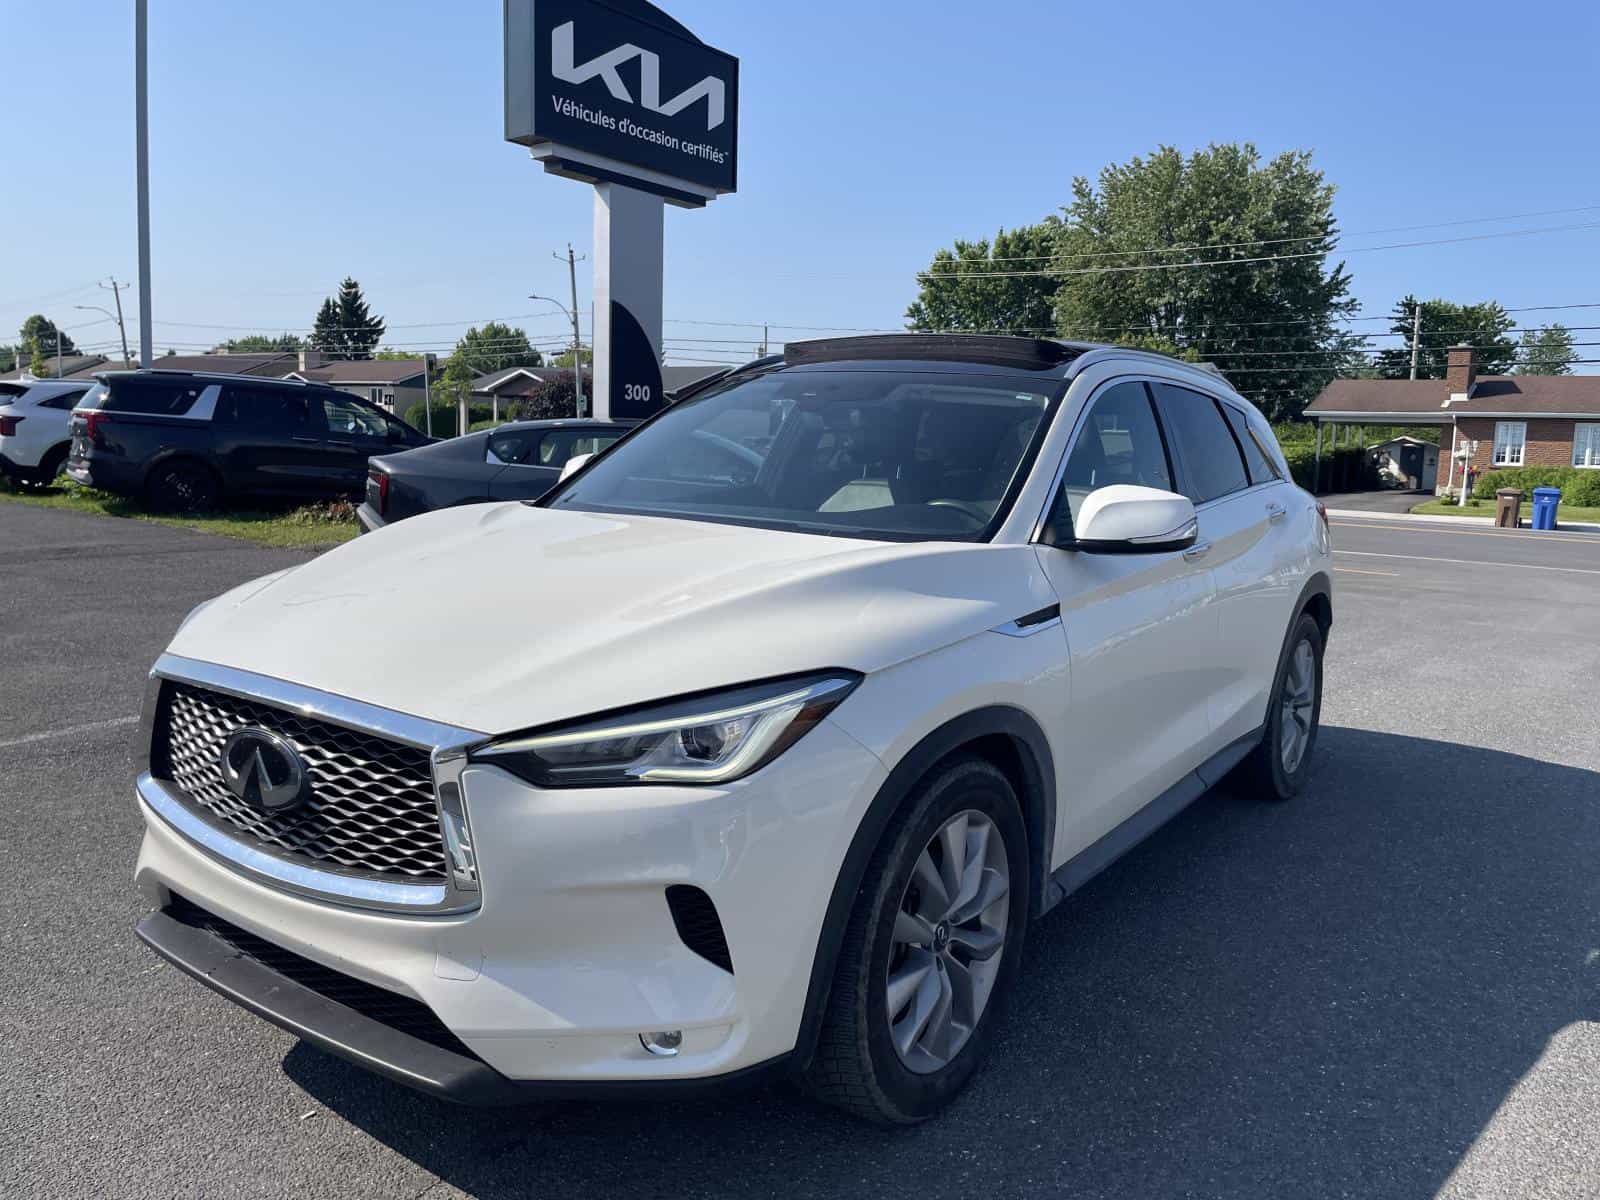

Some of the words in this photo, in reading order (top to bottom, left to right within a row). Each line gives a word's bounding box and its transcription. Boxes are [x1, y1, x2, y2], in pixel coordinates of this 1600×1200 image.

[552, 20, 725, 131] KIA
[552, 94, 616, 130] Véhicules
[618, 118, 679, 150] d'occasion
[681, 141, 724, 164] certifiés
[624, 383, 651, 402] 300
